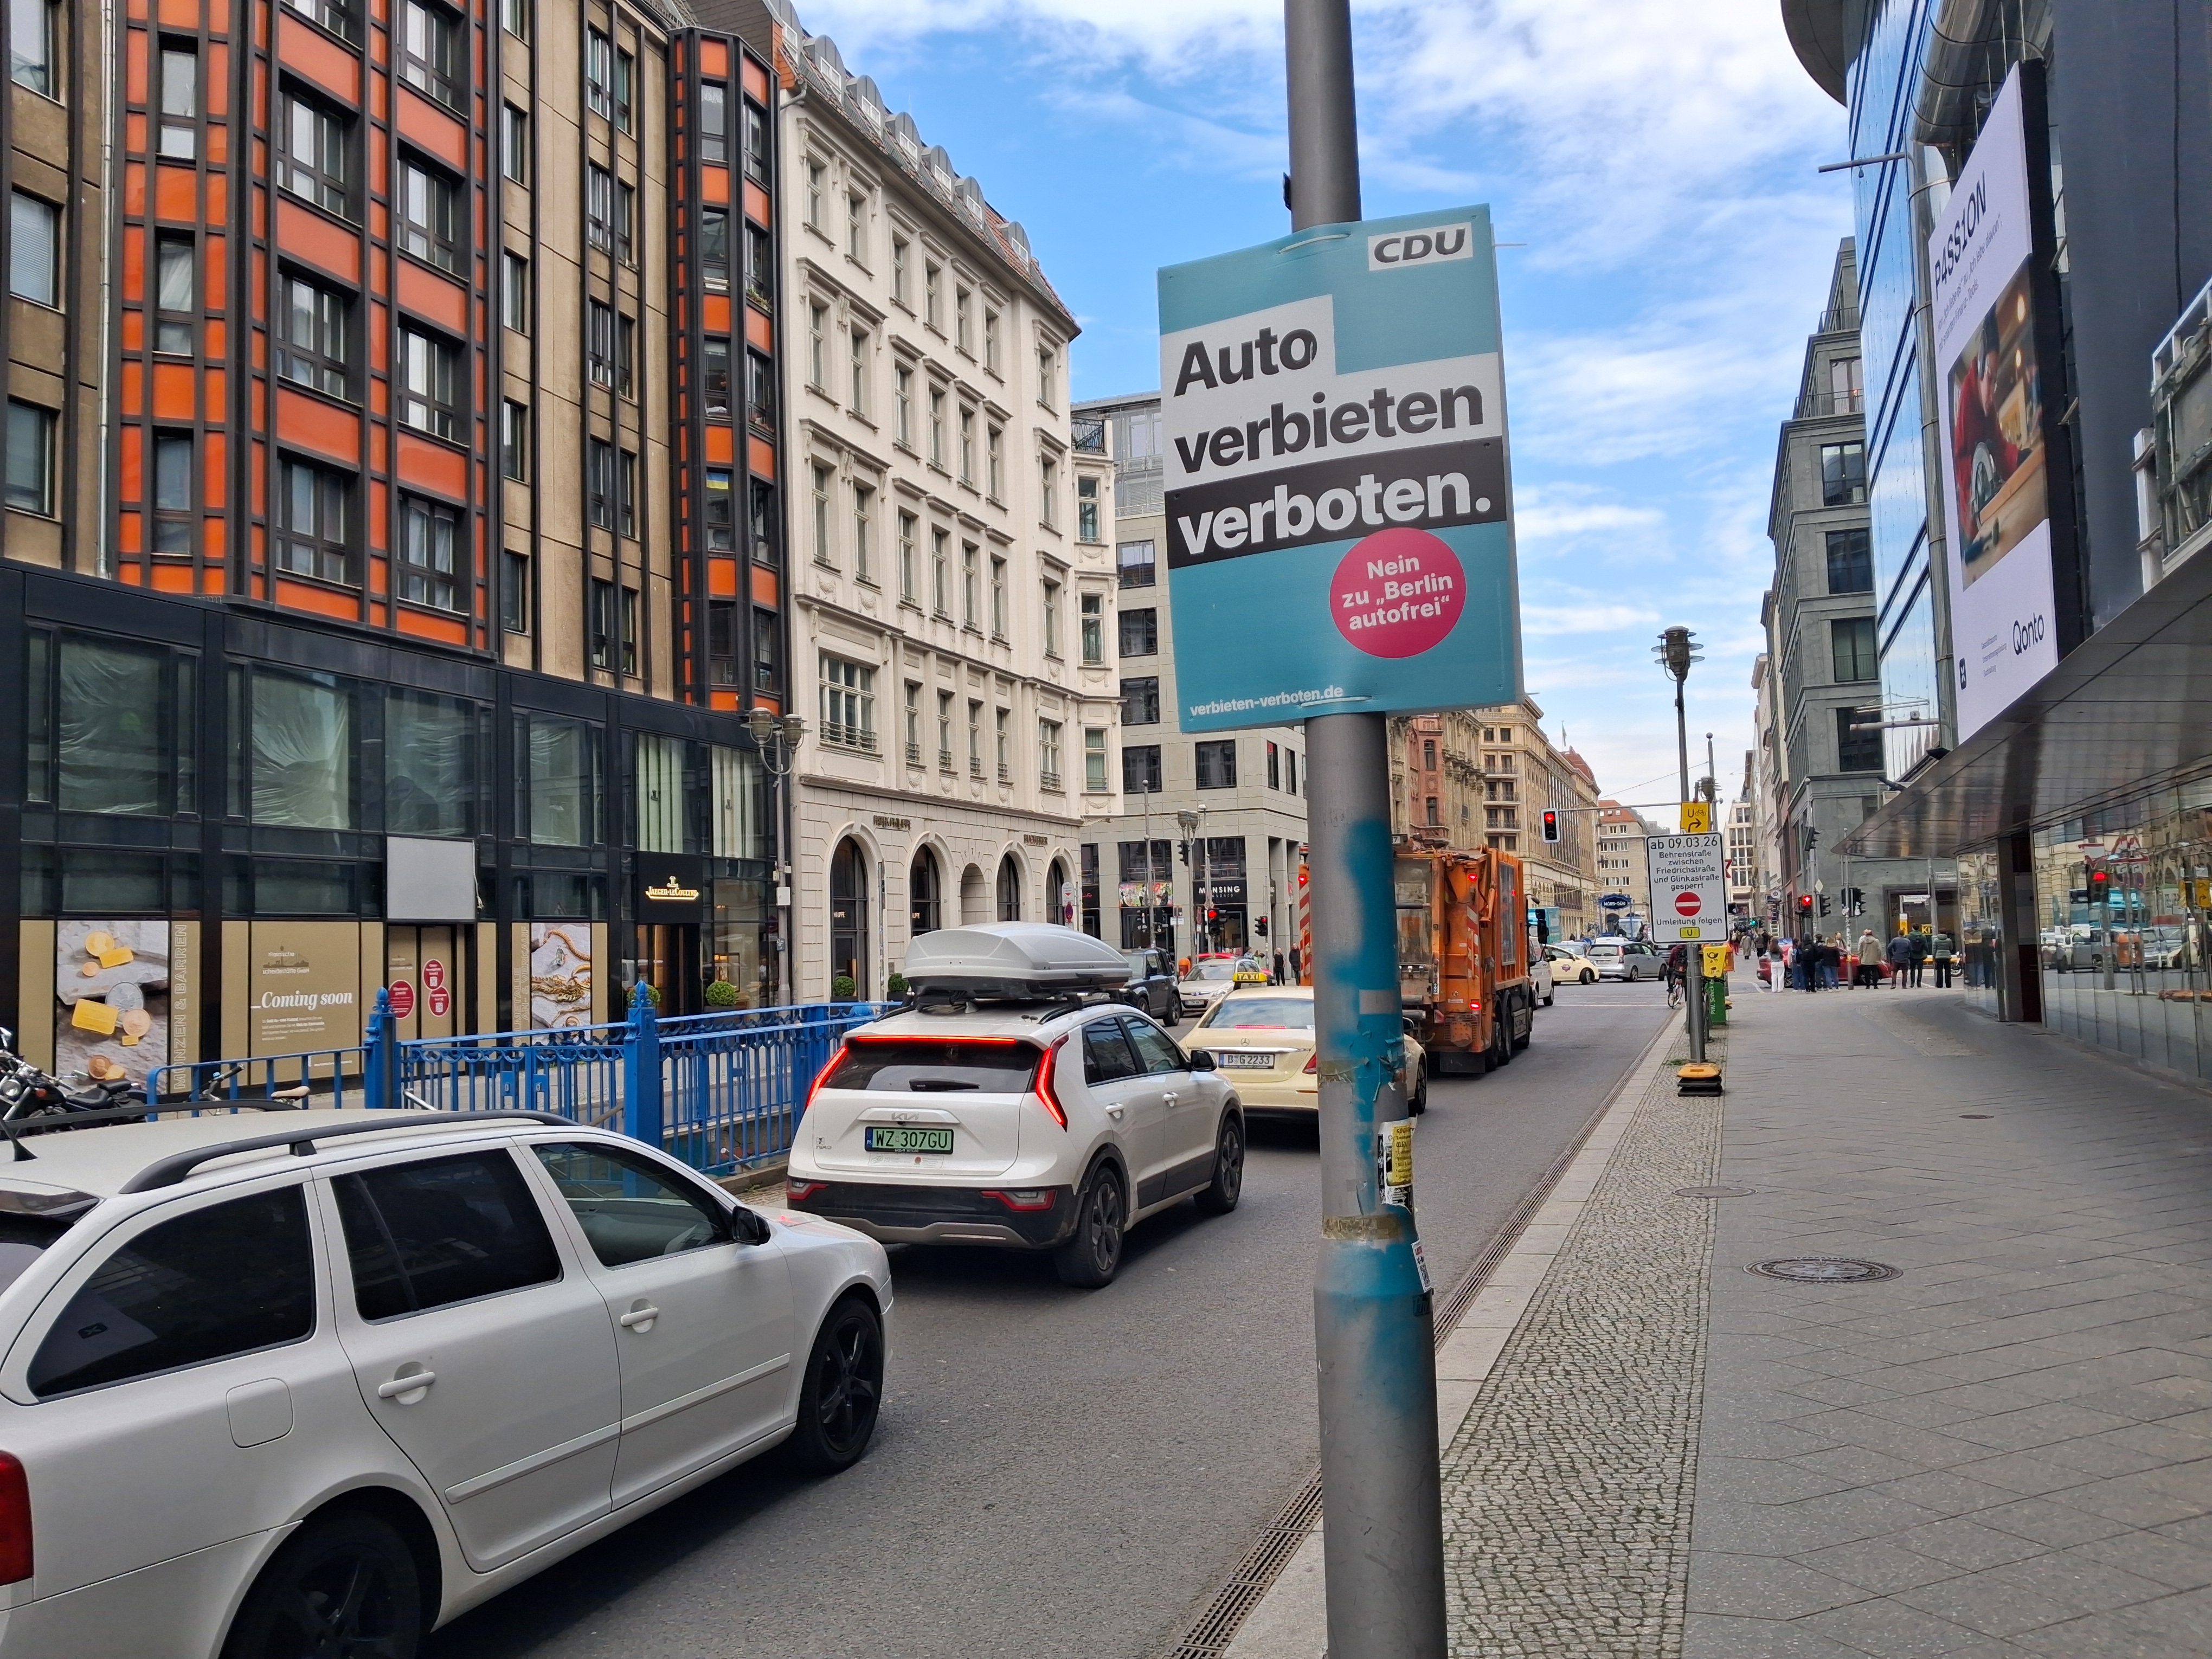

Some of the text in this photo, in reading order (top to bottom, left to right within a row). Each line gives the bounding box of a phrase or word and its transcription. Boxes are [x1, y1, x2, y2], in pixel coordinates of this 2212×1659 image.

[1373, 228, 1467, 263] CDU
[1174, 326, 1317, 397] Auto
[1174, 384, 1484, 474] verbieten
[1177, 471, 1491, 555] verboten.
[1367, 554, 1420, 580] Nein
[1342, 573, 1453, 608] zu „Berlin
[1349, 595, 1450, 630] autofrei“
[2013, 612, 2044, 655] Qonto
[1189, 684, 1343, 716] verbieten-verboten.de
[1687, 808, 1694, 818] U
[1650, 835, 1718, 849] ab 09.03.26
[1659, 850, 1712, 858] Behrenstraße
[1656, 865, 1716, 874] Friedrichstraße
[1670, 873, 1720, 883] Glinkastraße
[1199, 886, 1240, 894] MNSING
[1670, 882, 1704, 891] gesperrt
[1698, 917, 1722, 926] folgen
[175, 924, 187, 994] BARREN
[521, 926, 529, 985] VERKAUF
[174, 998, 187, 1010] &
[261, 990, 352, 1011] Coming soon
[1227, 1054, 1233, 1064] B
[1247, 1055, 1270, 1064] 2233
[876, 1130, 894, 1147] WZ
[901, 1131, 948, 1148] 307GU
